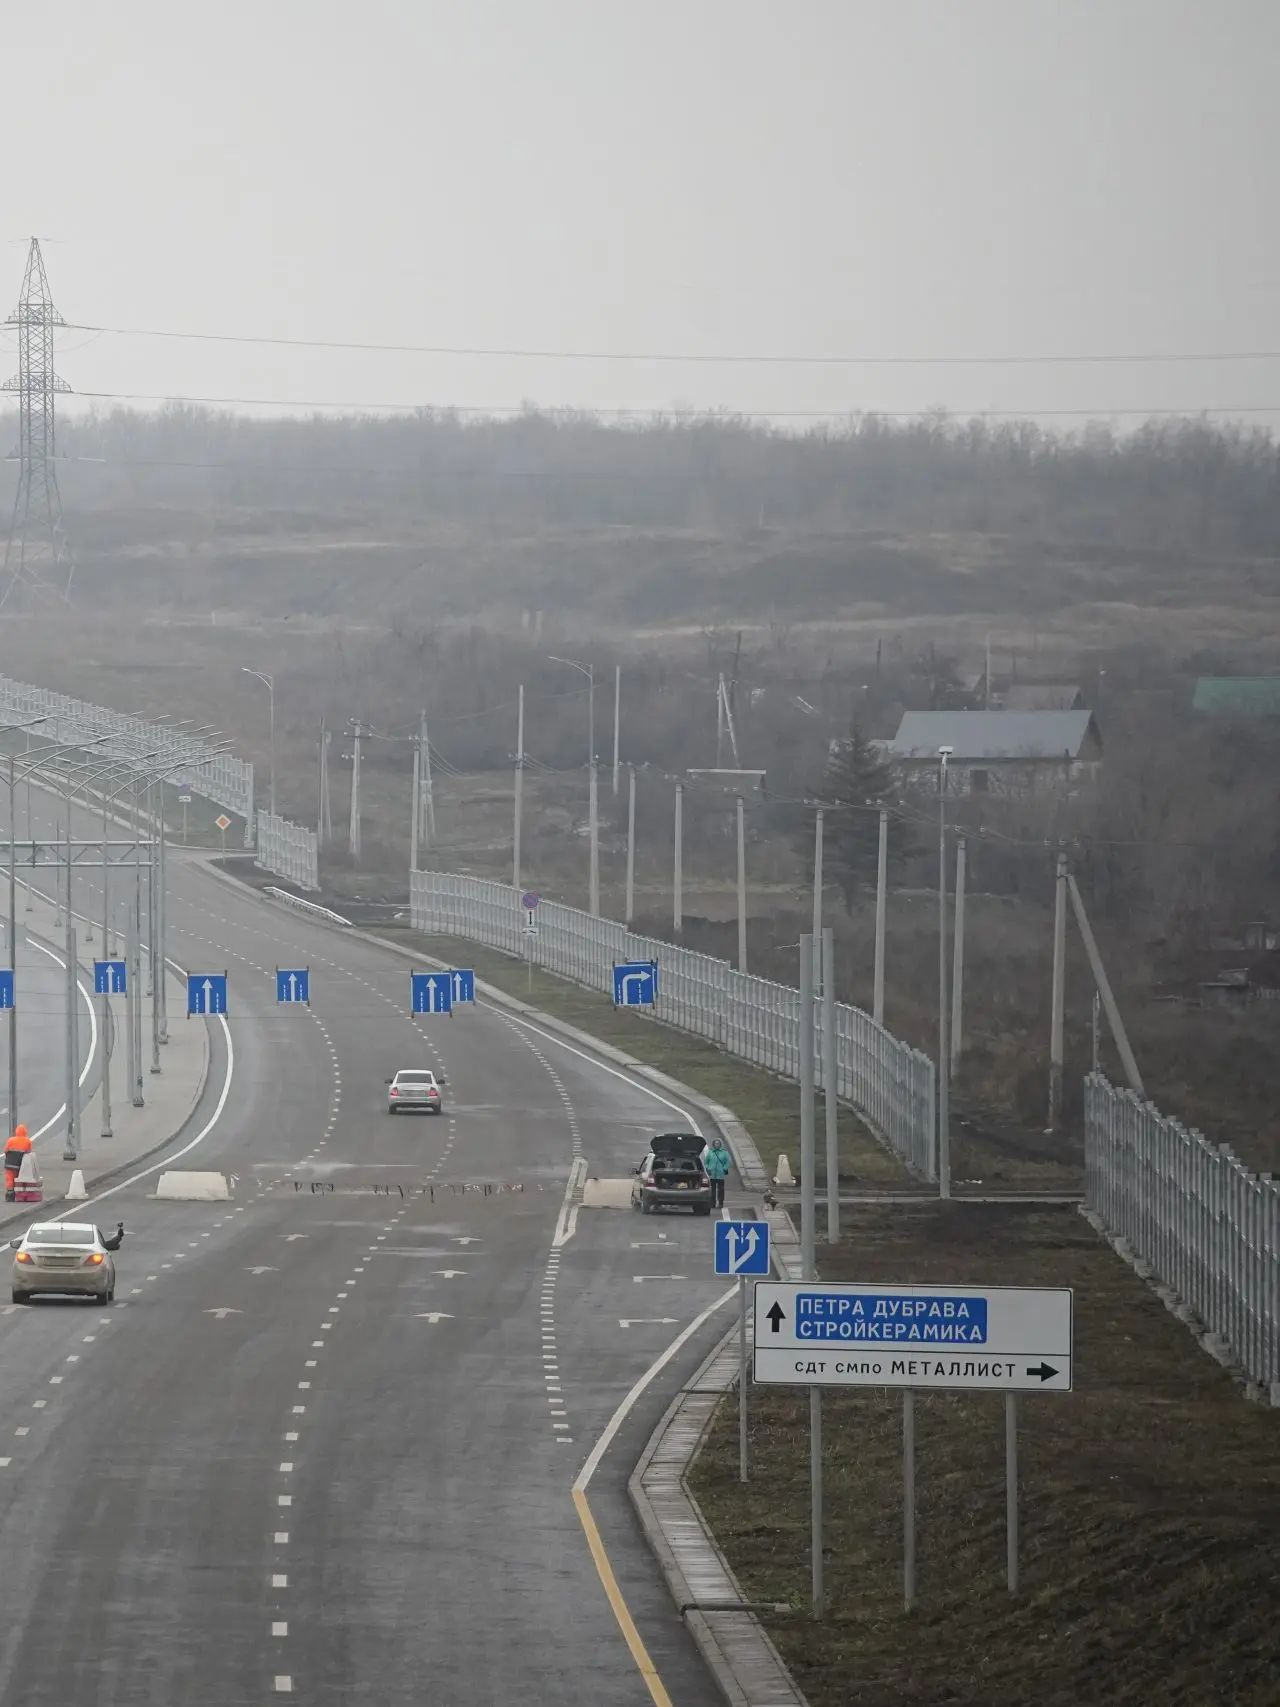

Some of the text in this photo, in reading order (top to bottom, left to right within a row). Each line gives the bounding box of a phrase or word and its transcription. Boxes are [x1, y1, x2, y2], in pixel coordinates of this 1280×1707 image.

[800, 1299, 970, 1318] ПЕТРА ДУБРАВА
[800, 1319, 982, 1340] СТРОЙКЕРАМИКА
[891, 1361, 1016, 1377] МЕТАЛЛИСТ
